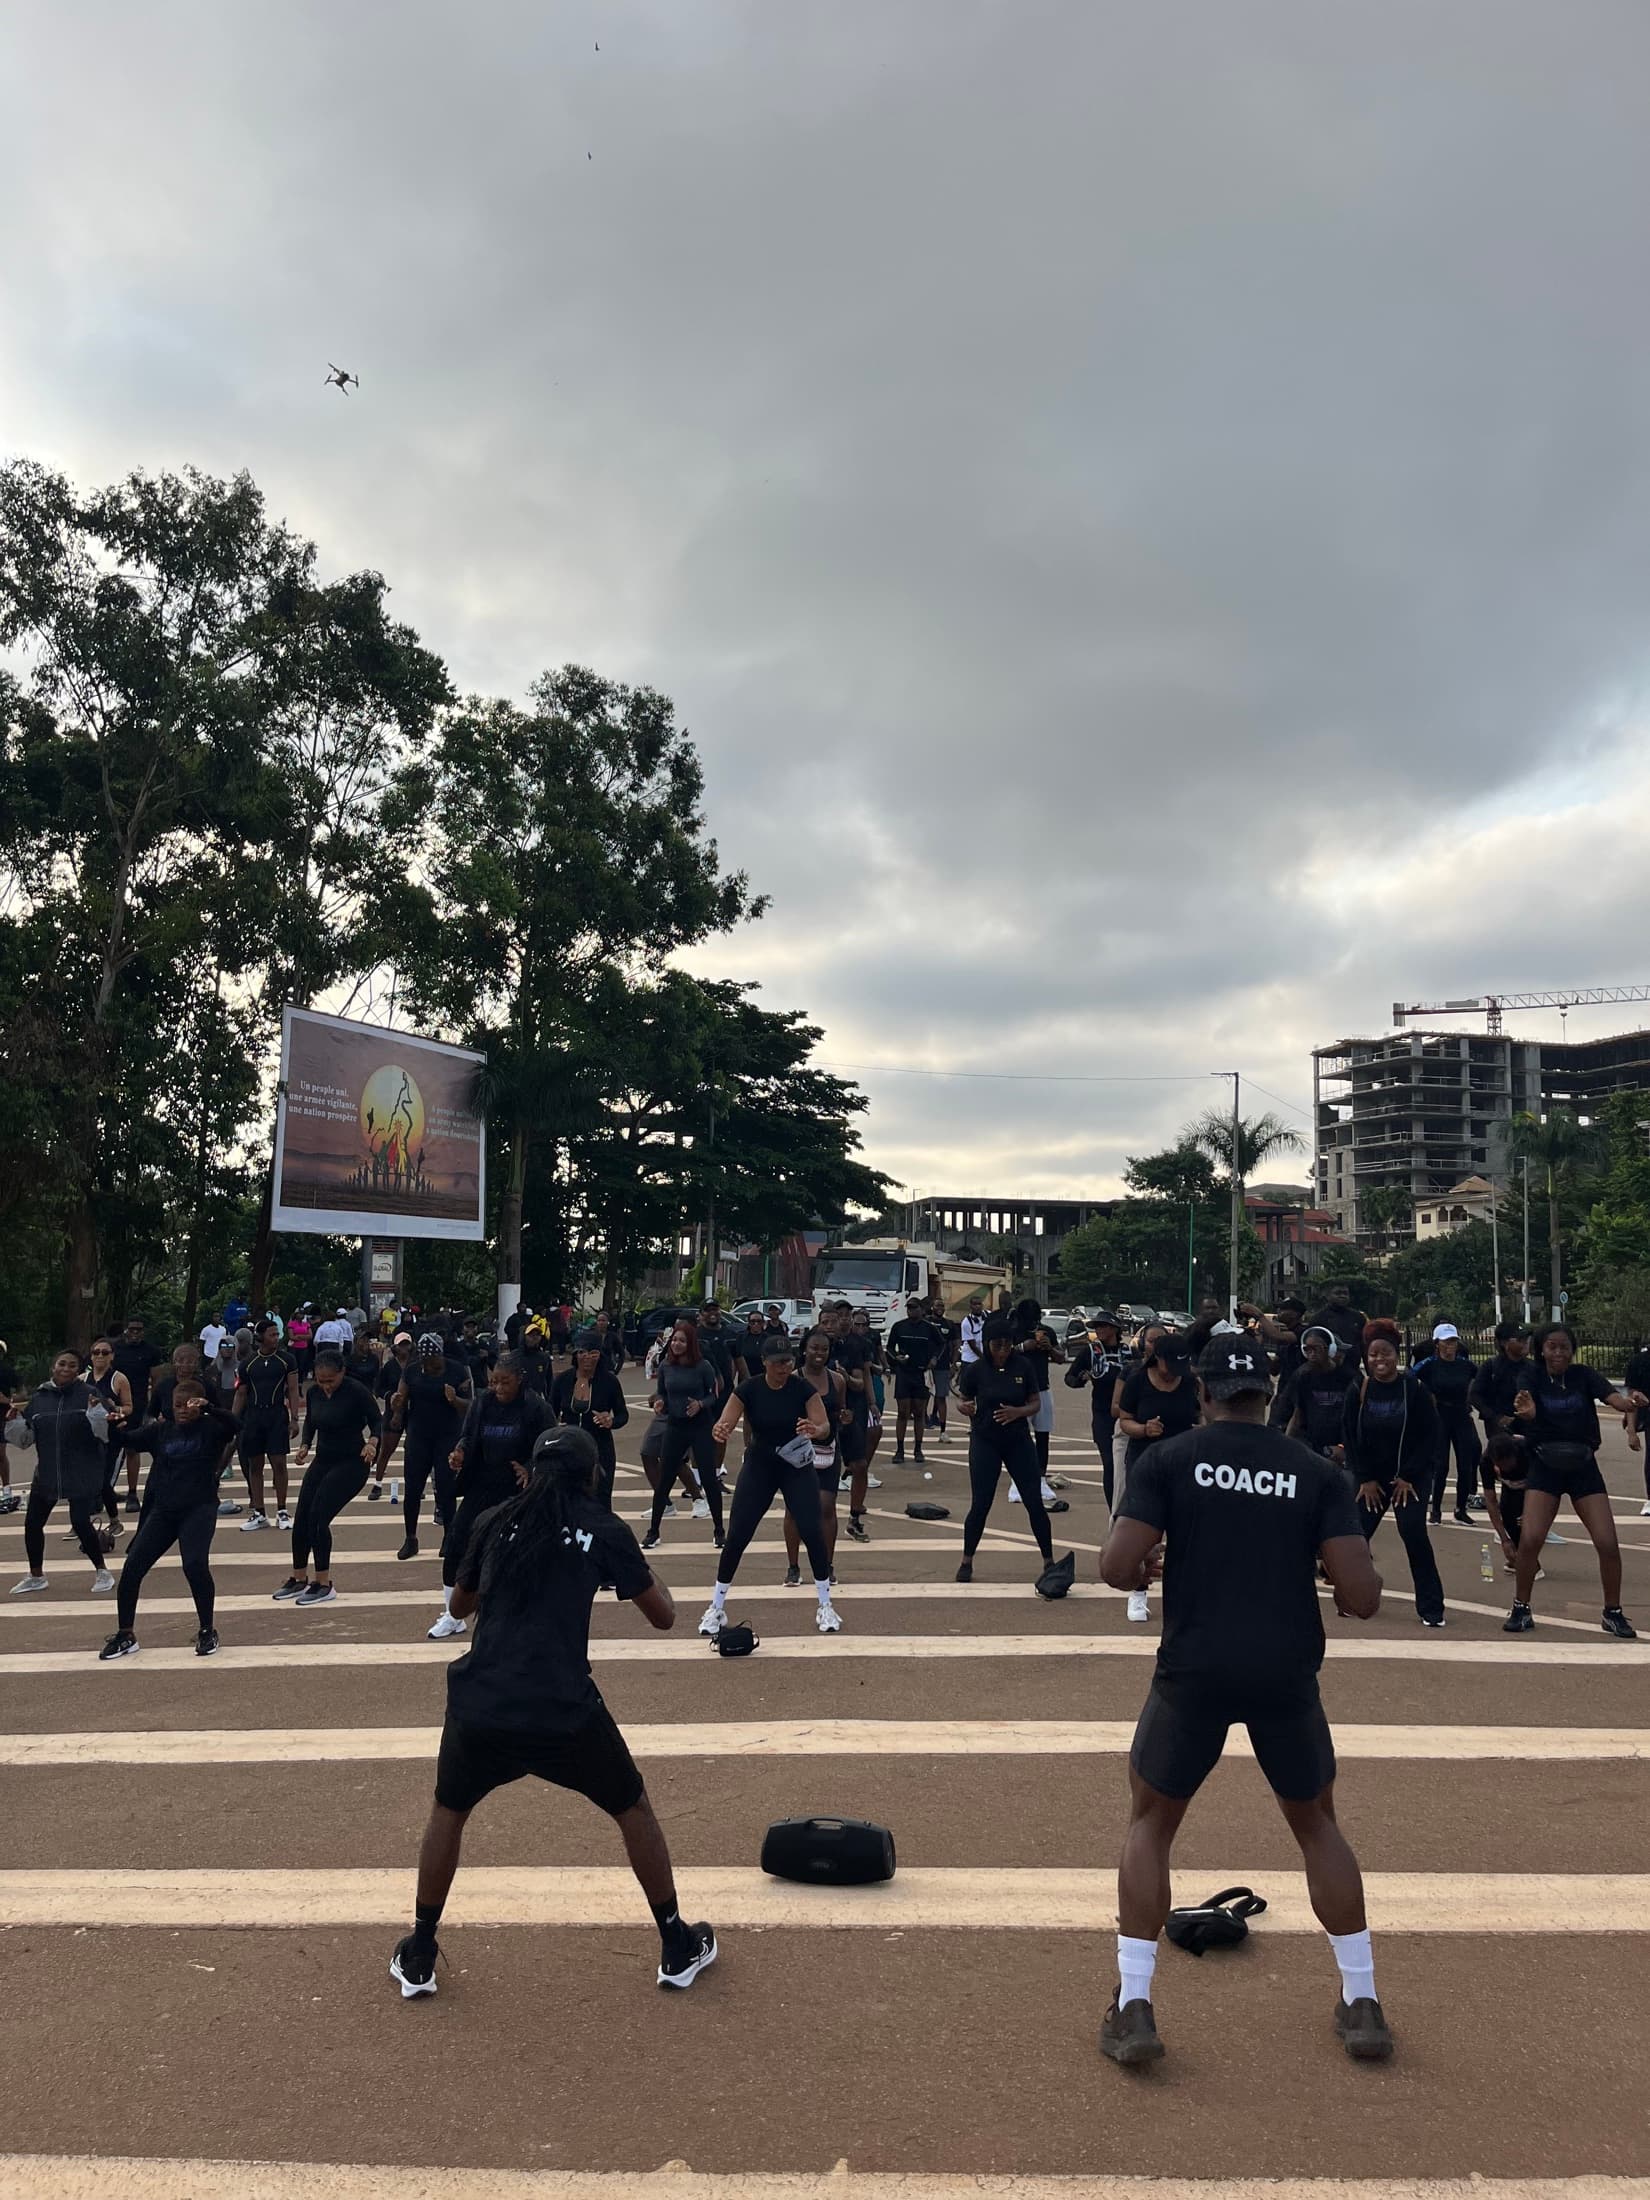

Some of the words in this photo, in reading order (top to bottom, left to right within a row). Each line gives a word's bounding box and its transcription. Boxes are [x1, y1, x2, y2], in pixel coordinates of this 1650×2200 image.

[300, 1080, 310, 1091] Un
[311, 1084, 335, 1096] peuple
[289, 1093, 303, 1101] une
[304, 1096, 326, 1105] armée
[288, 1105, 303, 1114] une
[303, 1107, 326, 1118] nation
[327, 1111, 358, 1122] prospère
[1194, 1462, 1297, 1498] COACH
